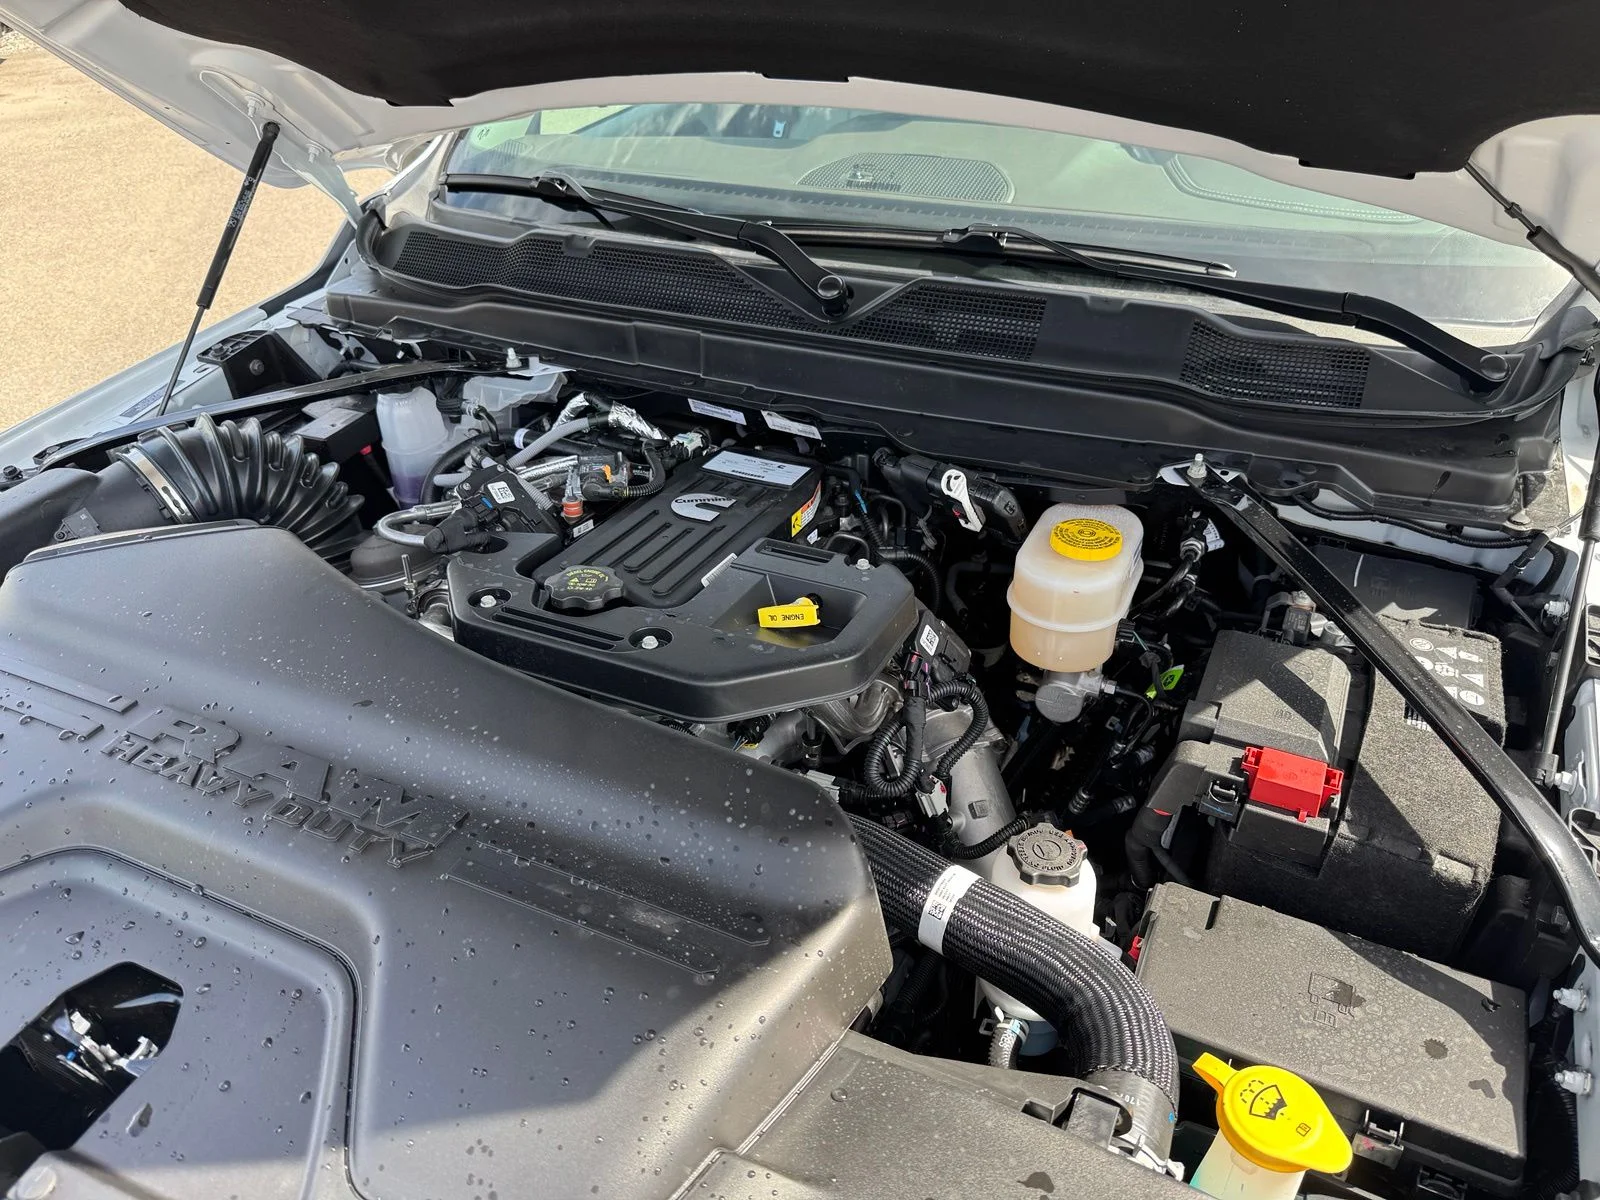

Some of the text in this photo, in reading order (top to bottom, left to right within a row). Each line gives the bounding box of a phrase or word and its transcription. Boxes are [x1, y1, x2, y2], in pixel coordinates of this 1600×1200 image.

[767, 613, 805, 622] ENGINE OIL
[100, 732, 436, 868] HEAVY DUTY
[126, 703, 471, 850] RAM
